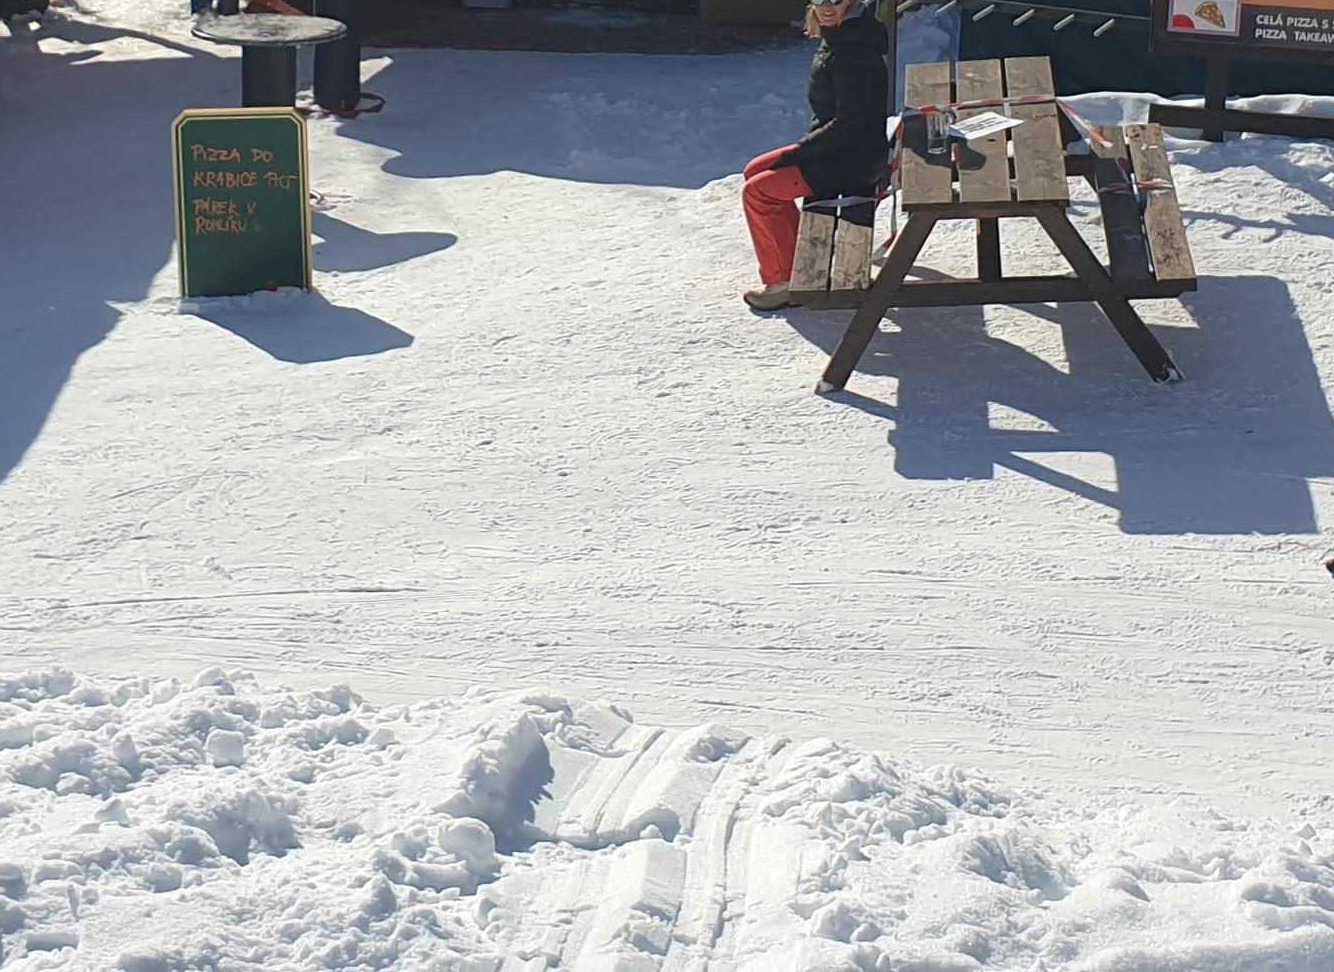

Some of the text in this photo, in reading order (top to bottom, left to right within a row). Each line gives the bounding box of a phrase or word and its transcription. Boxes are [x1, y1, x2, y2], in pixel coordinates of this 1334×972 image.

[1256, 13, 1283, 26] CELÁ
[1287, 17, 1318, 28] PIZZA
[1321, 19, 1328, 29] S
[1255, 28, 1286, 40] PIZZA
[191, 144, 273, 162] PIZZA DO
[193, 171, 258, 188] KRABICE
[193, 197, 239, 217] PÁREK
